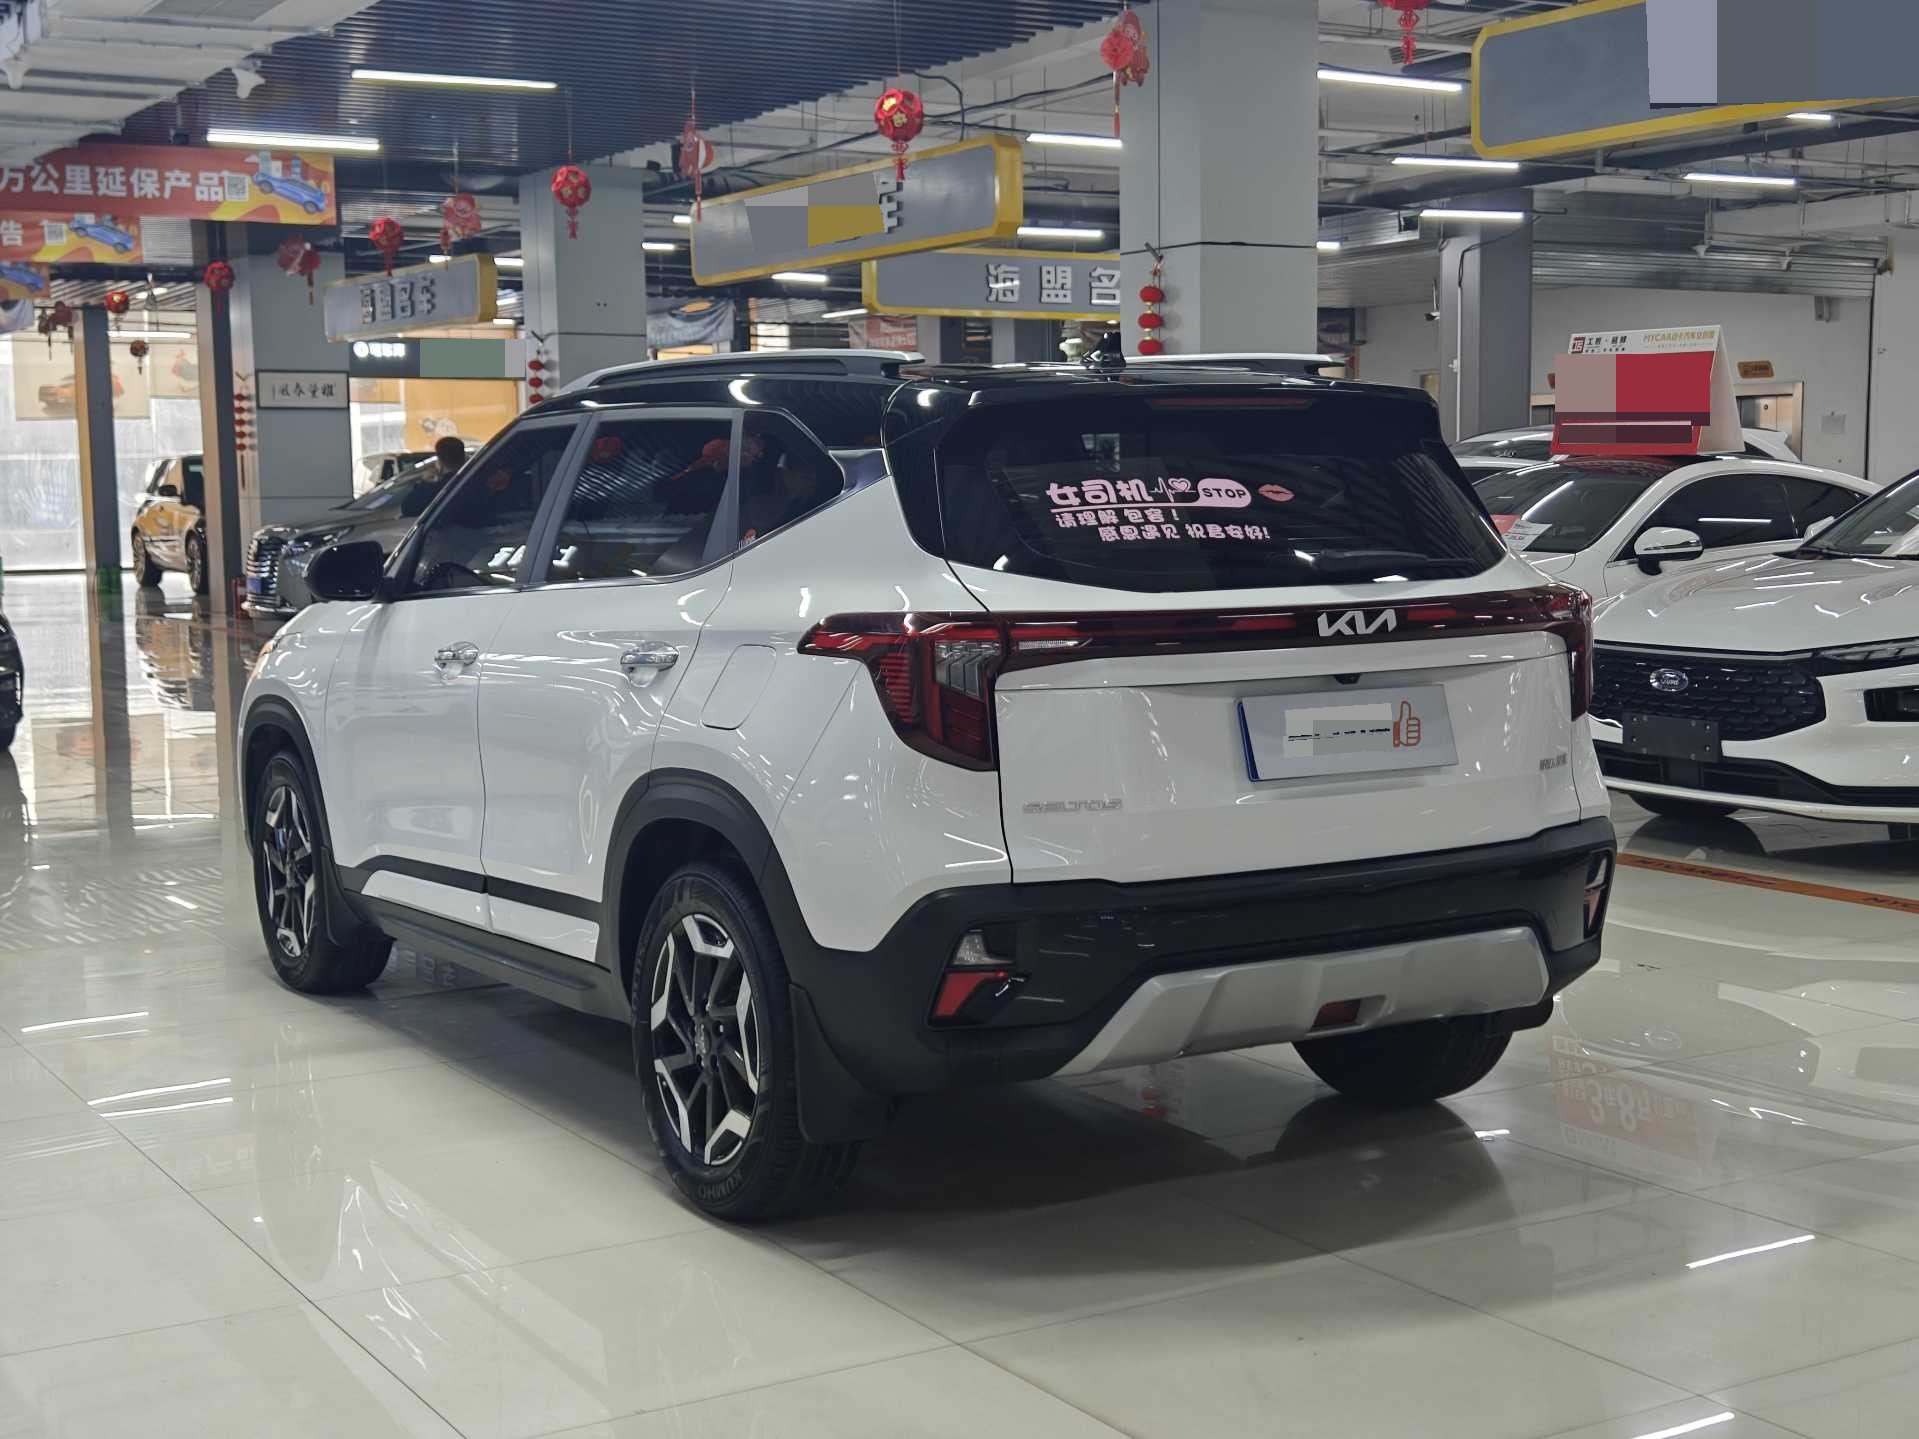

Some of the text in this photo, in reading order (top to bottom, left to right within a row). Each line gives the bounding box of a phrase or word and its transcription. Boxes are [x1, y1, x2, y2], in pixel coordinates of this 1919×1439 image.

[1046, 478, 1153, 506] 女司机
[1202, 486, 1247, 500] STOP
